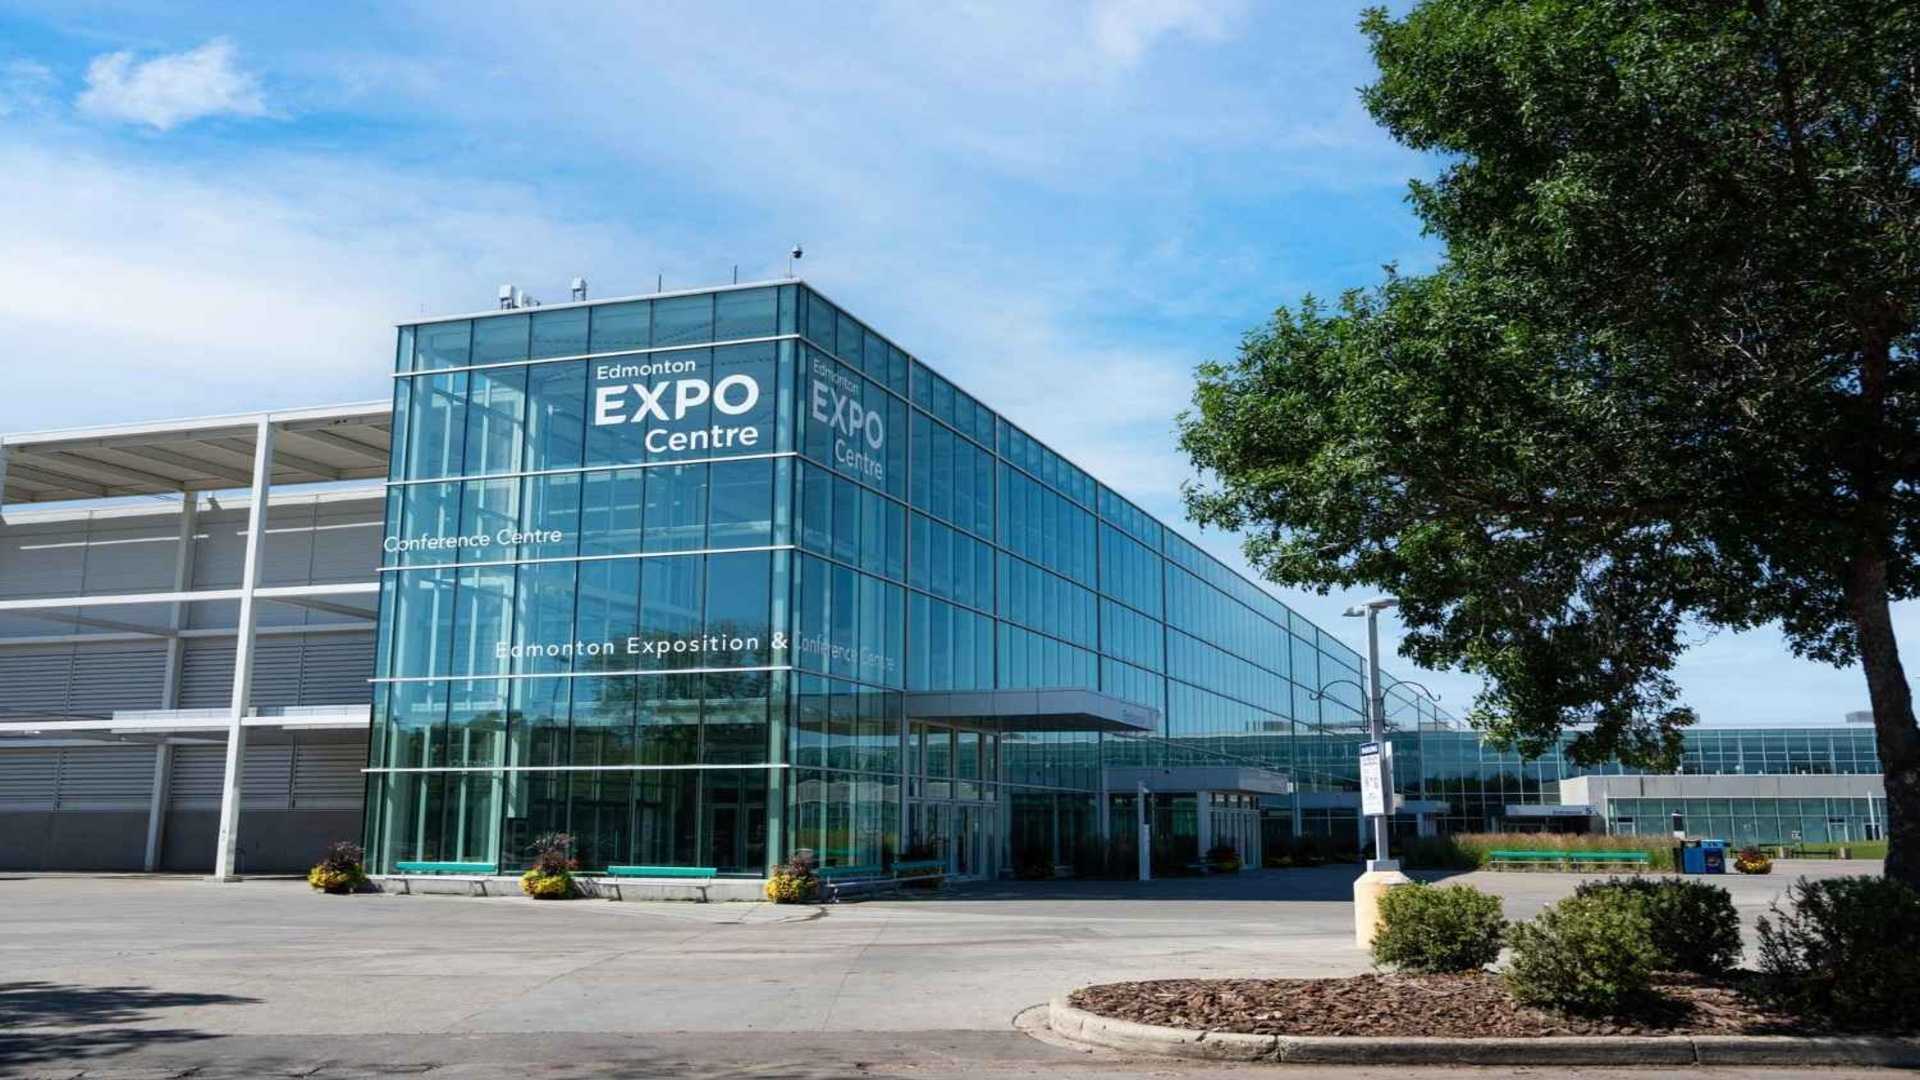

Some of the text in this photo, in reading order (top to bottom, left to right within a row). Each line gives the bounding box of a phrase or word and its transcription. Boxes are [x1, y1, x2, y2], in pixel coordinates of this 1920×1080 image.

[597, 359, 696, 381] Edmonton
[813, 359, 860, 394] Edmonton
[594, 374, 760, 426] EXPO
[812, 379, 884, 450] EXPO
[644, 426, 759, 454] Centre
[834, 438, 884, 481] Centre
[384, 527, 563, 553] Conference Centre
[496, 632, 788, 659] Edmonton Exposition &
